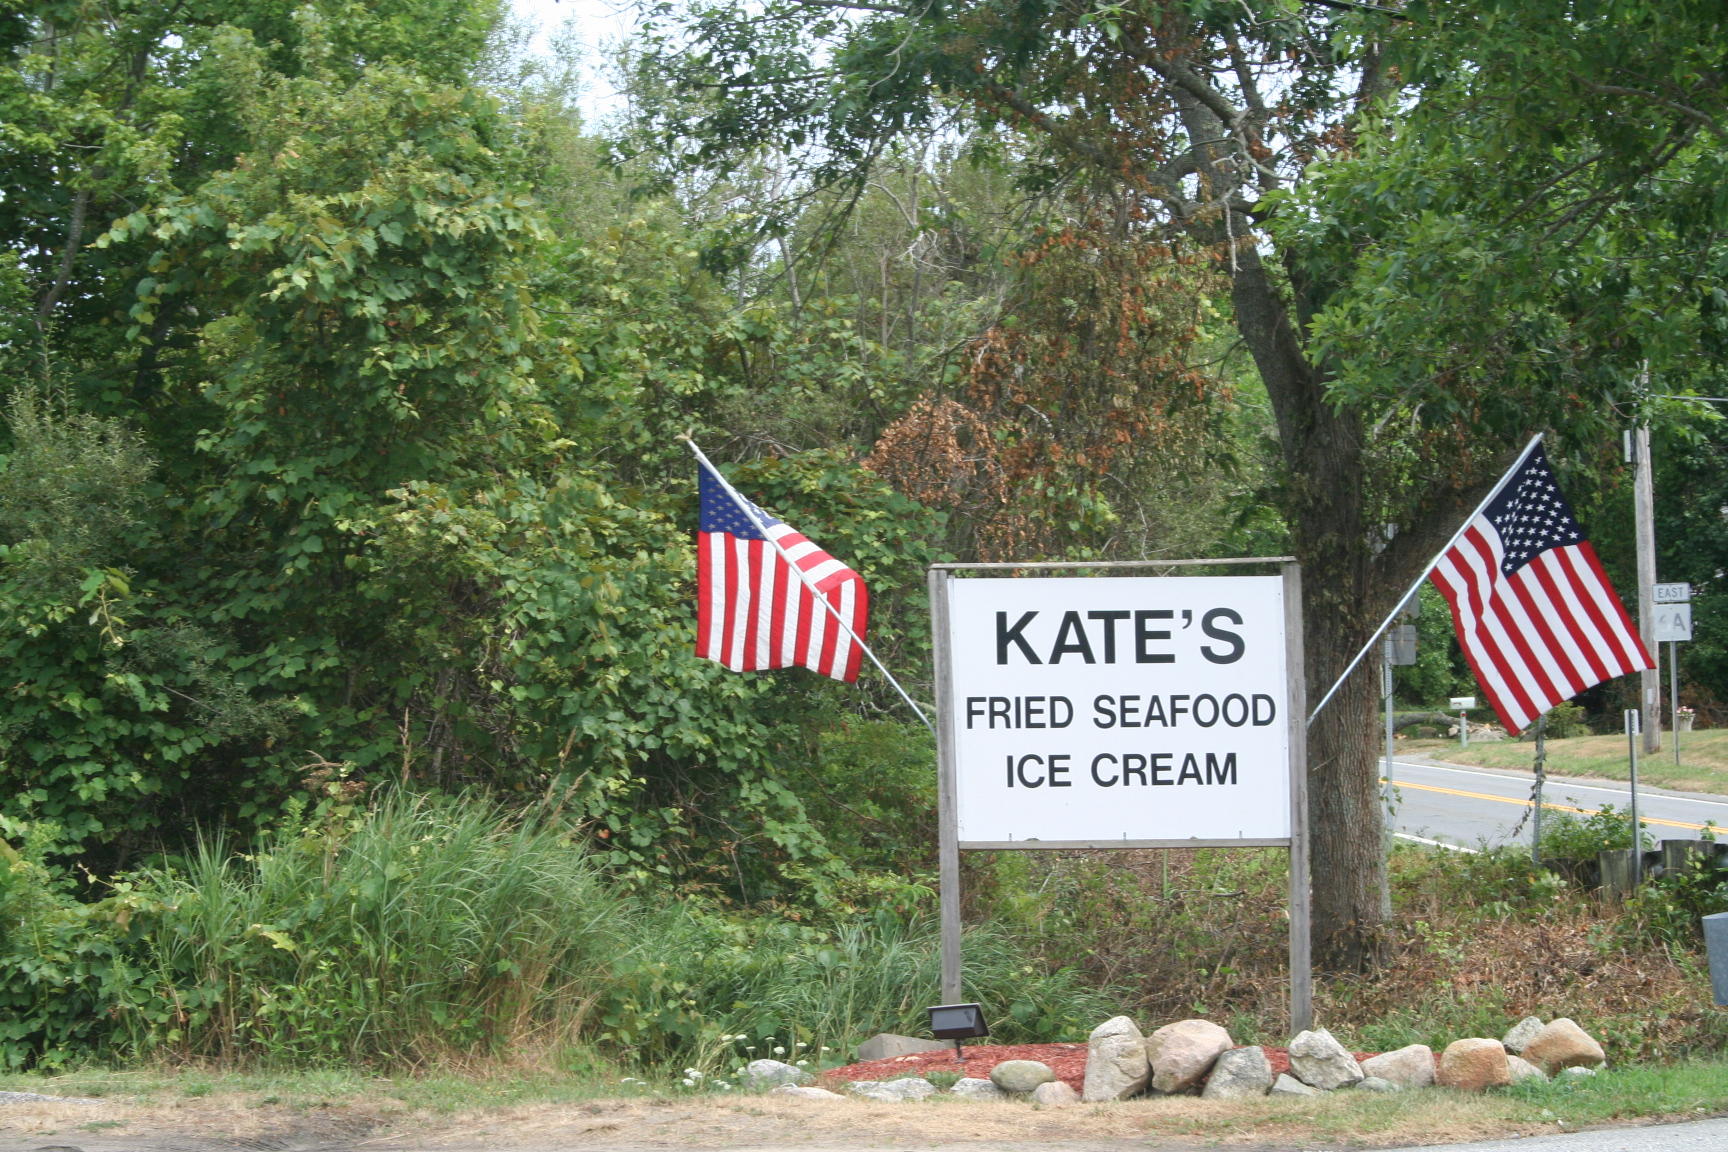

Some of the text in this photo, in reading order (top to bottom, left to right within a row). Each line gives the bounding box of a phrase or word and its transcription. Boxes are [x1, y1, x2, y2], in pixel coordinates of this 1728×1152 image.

[1658, 587, 1683, 599] EAST
[996, 607, 1246, 665] KATE’S
[966, 693, 1276, 730] FRIED SEAFOOD
[1007, 752, 1237, 789] ICE CREAM
